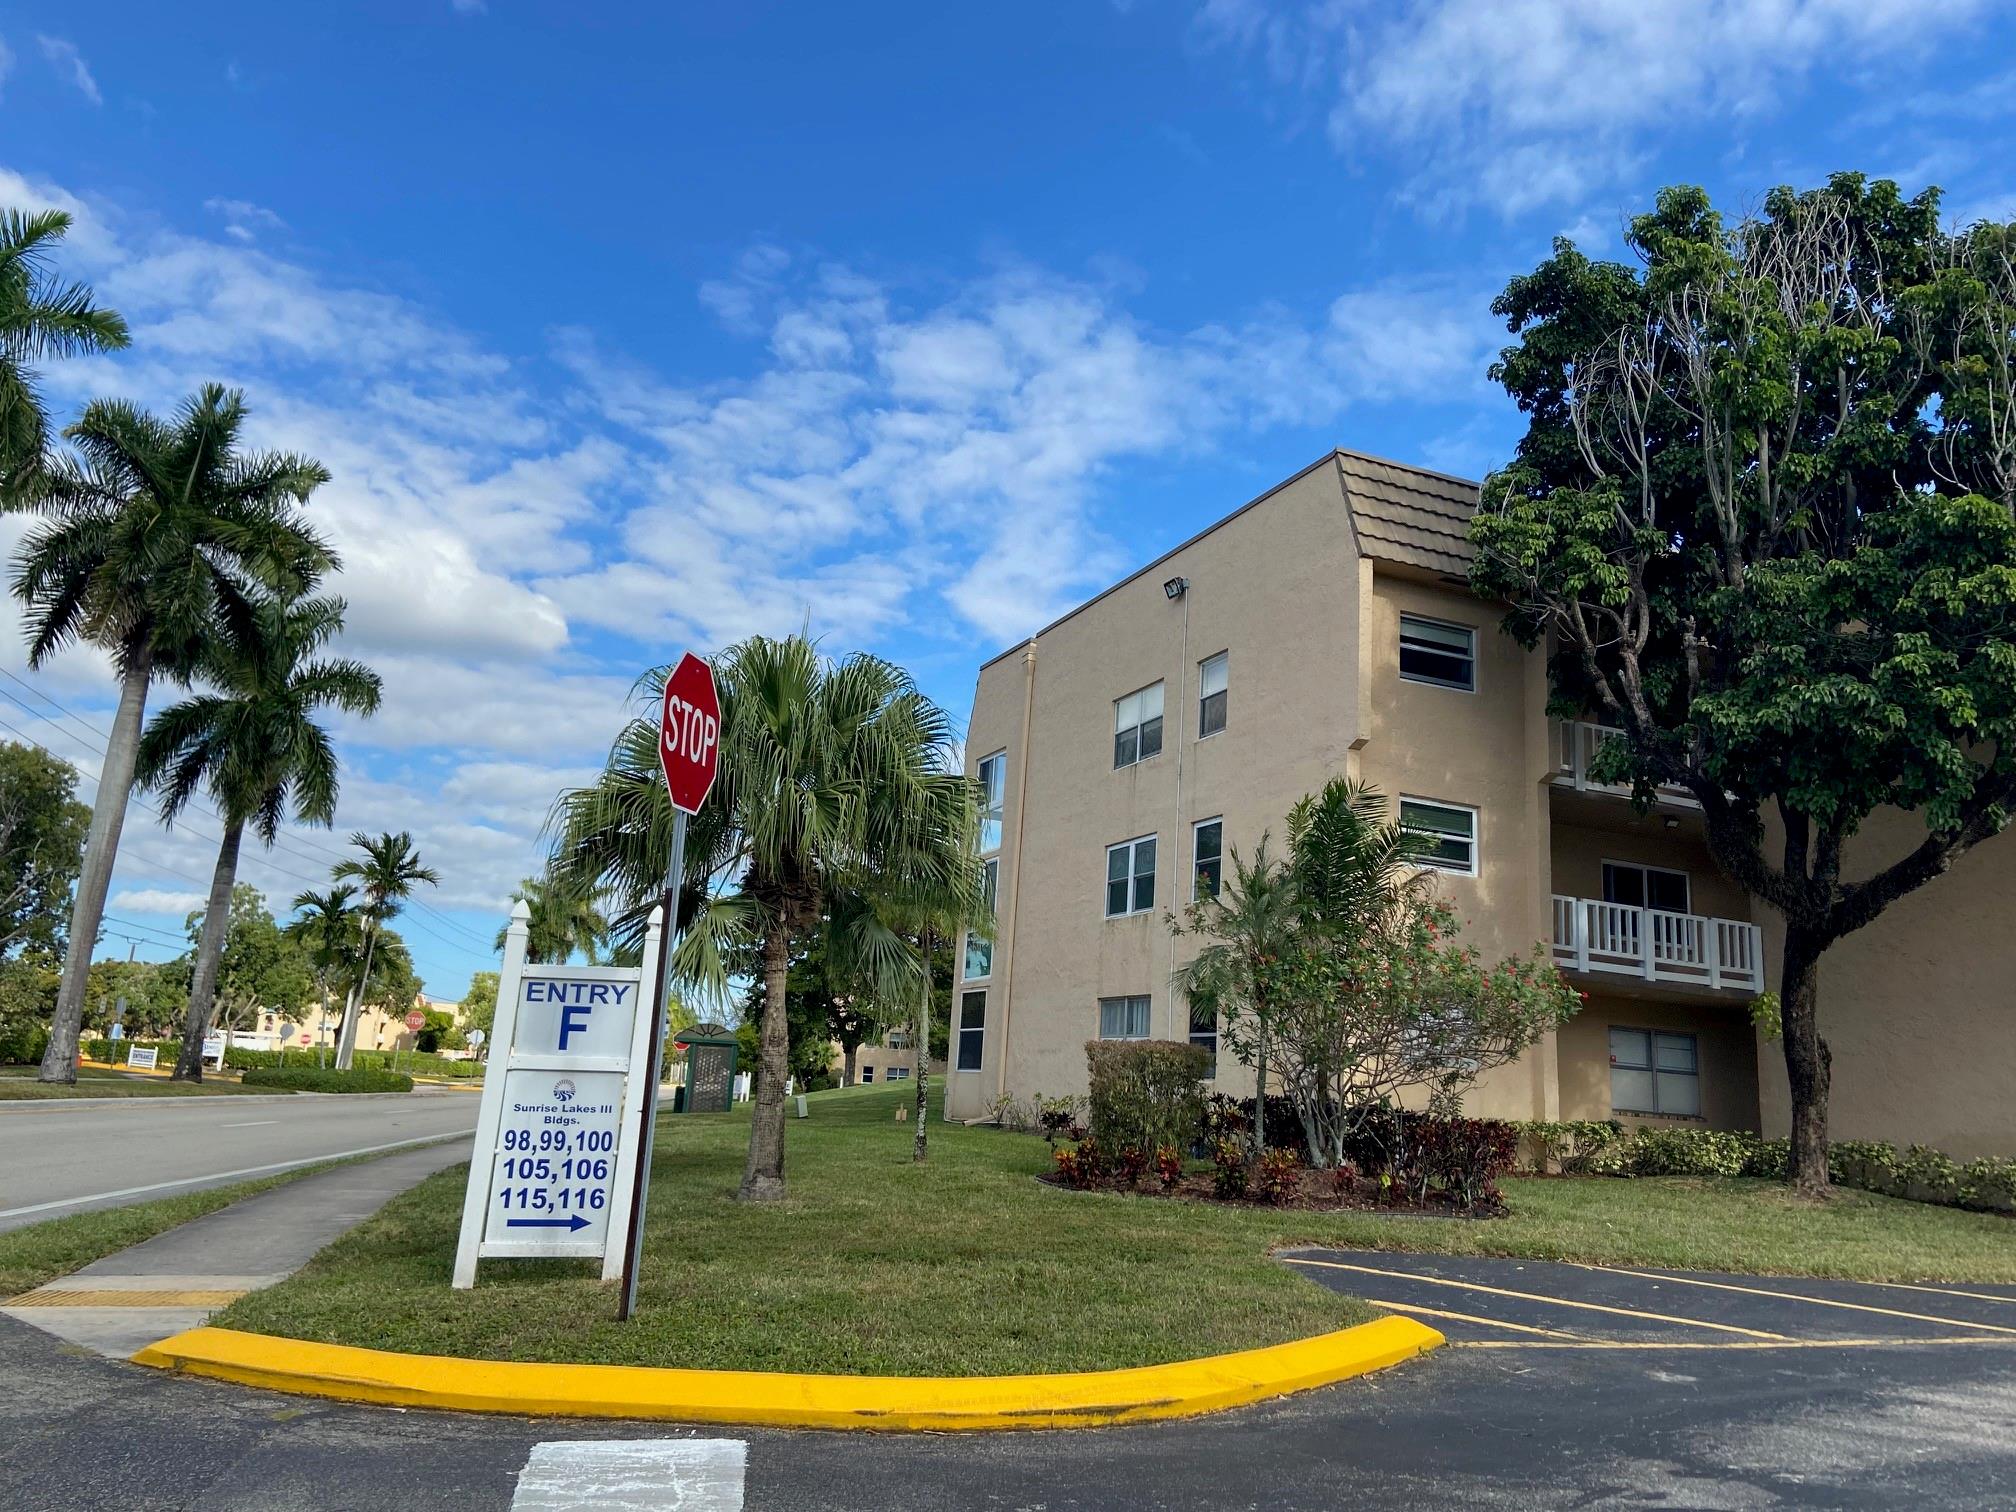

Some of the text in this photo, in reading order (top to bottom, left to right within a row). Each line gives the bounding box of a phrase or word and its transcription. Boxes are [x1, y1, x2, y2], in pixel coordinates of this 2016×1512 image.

[665, 694, 717, 767] STOP
[526, 981, 630, 1005] ENTRY
[406, 1016, 424, 1025] STOP
[558, 1005, 592, 1050] F
[513, 1103, 613, 1114] Sunrise Lakes III
[544, 1116, 580, 1126] Bldgs.
[504, 1129, 613, 1156] 98,99,100
[503, 1158, 608, 1184] 105,106
[500, 1187, 605, 1214] 115,116
